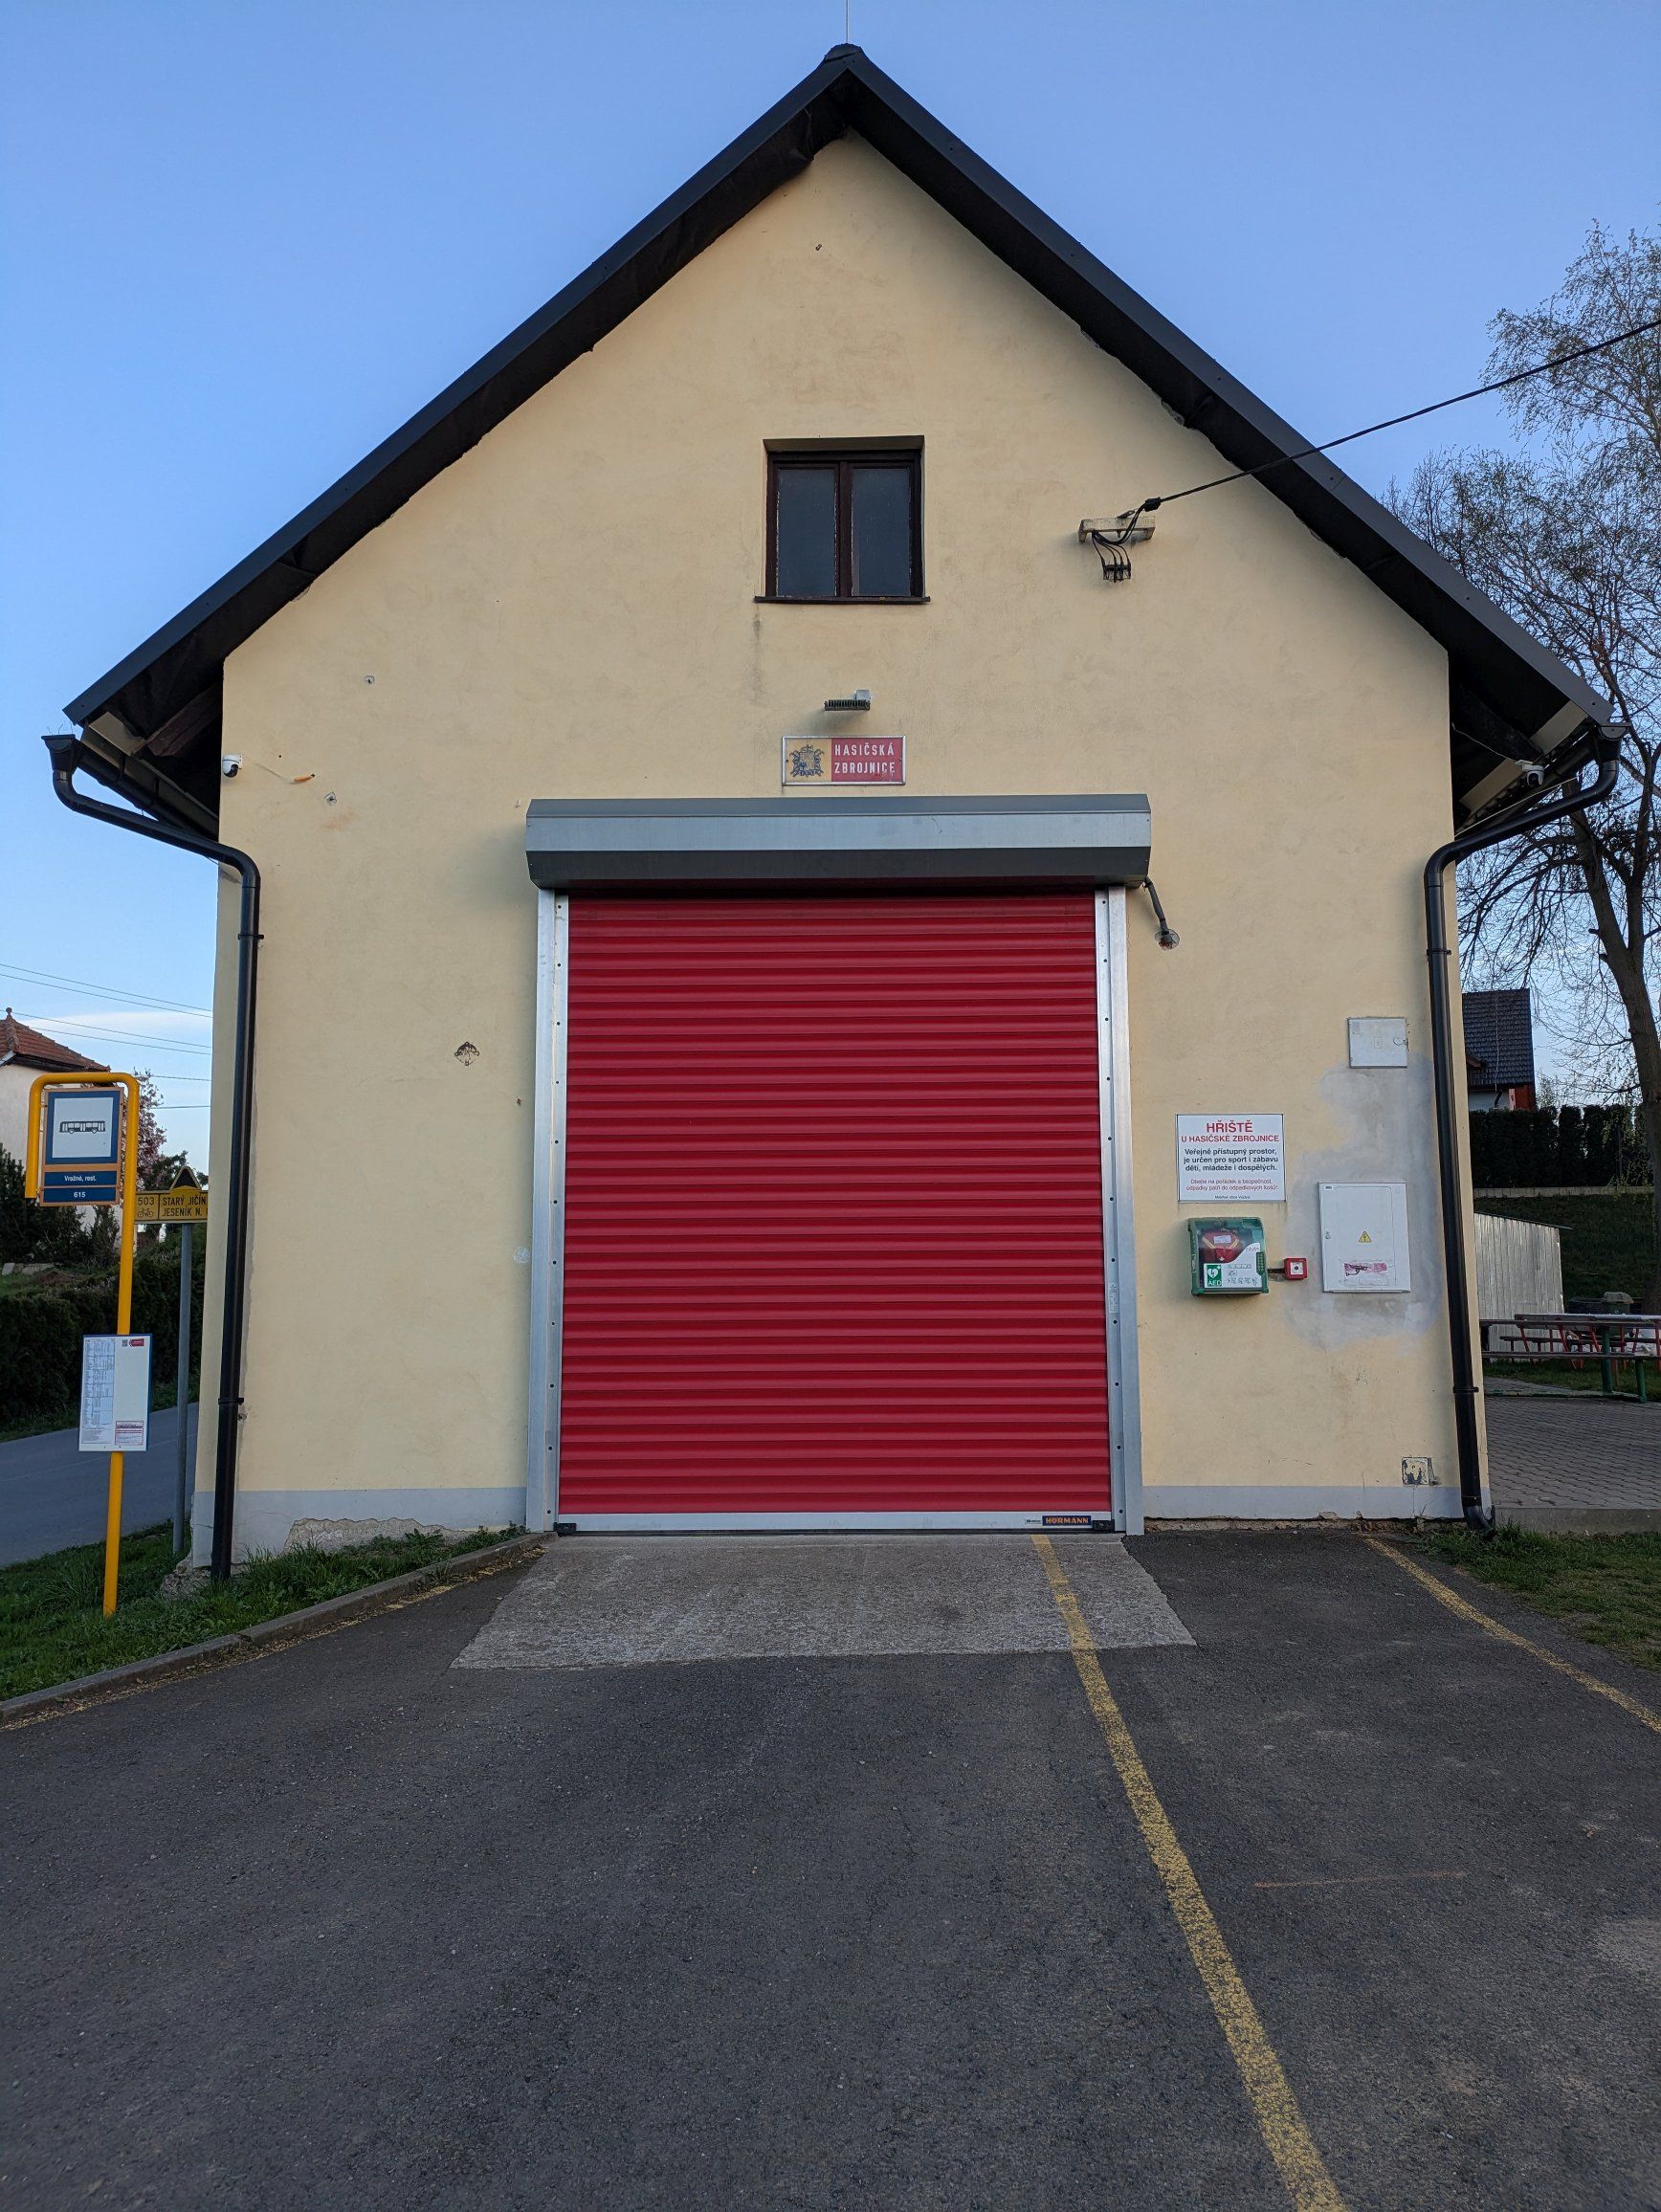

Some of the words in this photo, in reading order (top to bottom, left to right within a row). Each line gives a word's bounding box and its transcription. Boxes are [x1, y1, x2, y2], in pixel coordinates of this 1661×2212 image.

[834, 742, 895, 756] HASIČSKÁ
[834, 762, 896, 774] ZBROJNICE
[1207, 1119, 1253, 1133] HŘIŠTĚ
[1189, 1134, 1230, 1142] HASIČSKÉ
[1184, 1156, 1190, 1164] je
[1238, 1163, 1277, 1172] dospělých.
[138, 1196, 155, 1206] 503
[162, 1194, 185, 1206] STARÝ
[188, 1194, 207, 1206] JIČÍN
[162, 1206, 191, 1216] JESENÍK
[195, 1207, 203, 1216] N.
